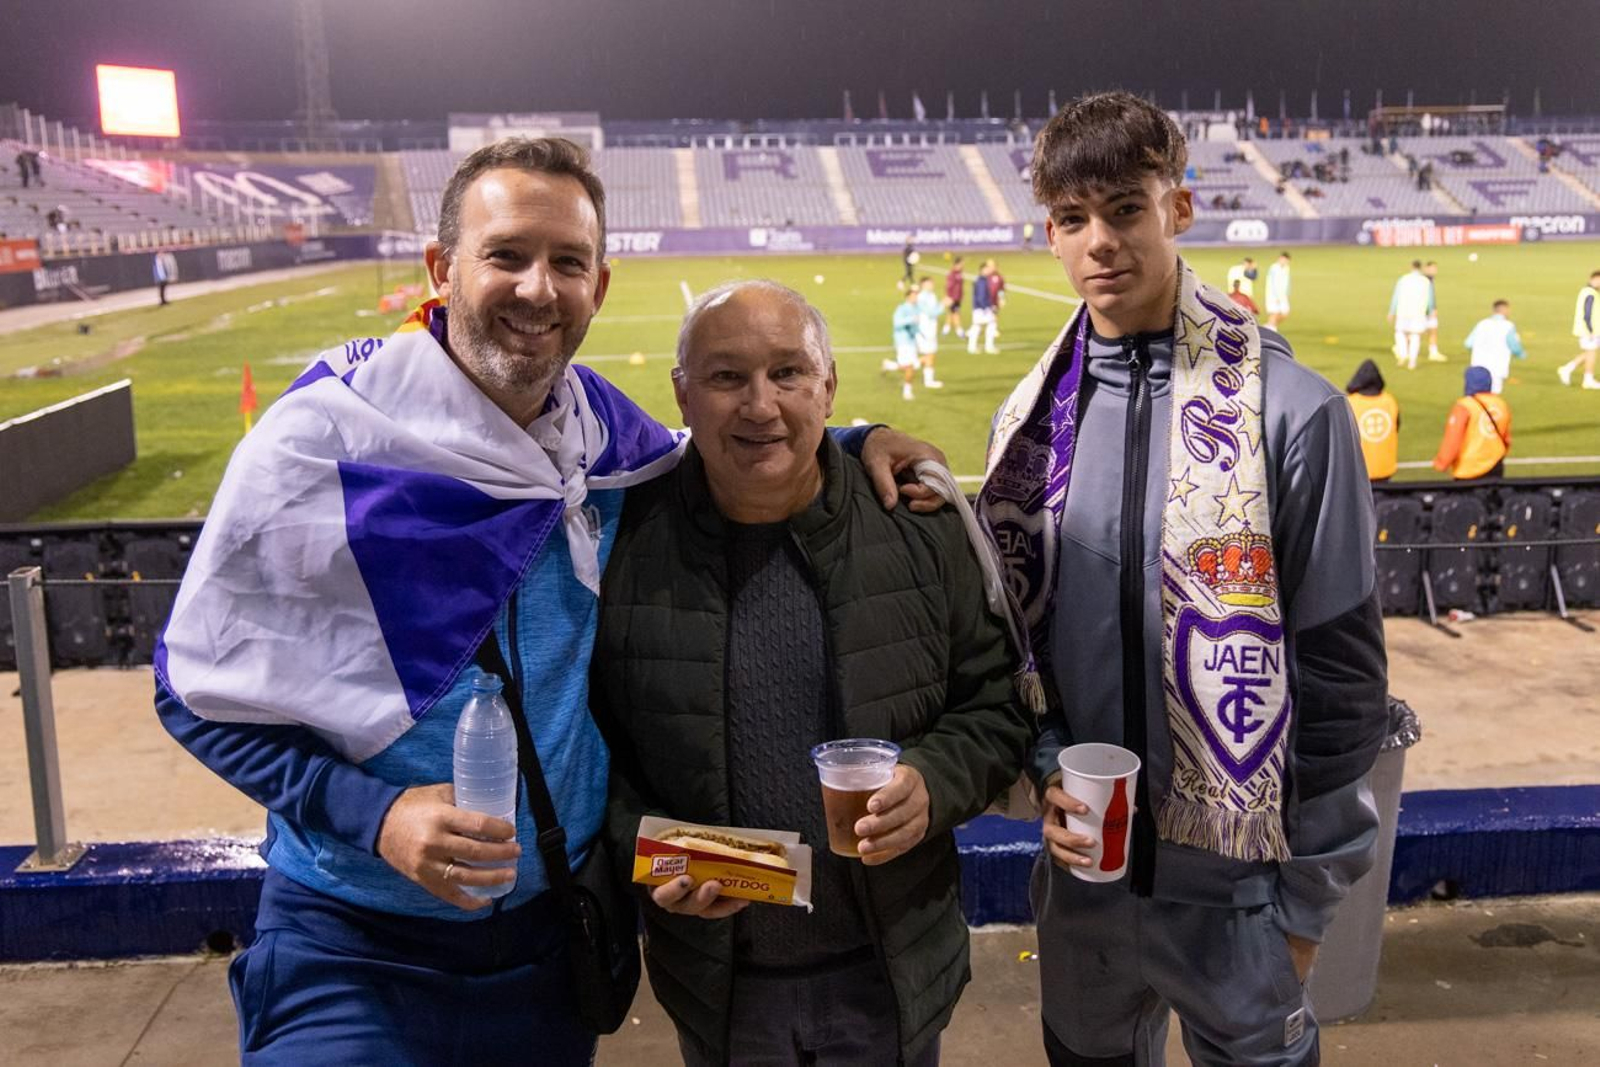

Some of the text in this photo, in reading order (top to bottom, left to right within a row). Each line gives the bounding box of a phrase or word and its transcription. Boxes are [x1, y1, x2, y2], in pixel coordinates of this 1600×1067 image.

[1181, 282, 1247, 472] Real
[1204, 644, 1280, 675] JAEN
[1175, 768, 1229, 799] Real
[654, 864, 687, 875] Mayer
[656, 857, 685, 866] Oscar
[740, 879, 770, 892] DOG
